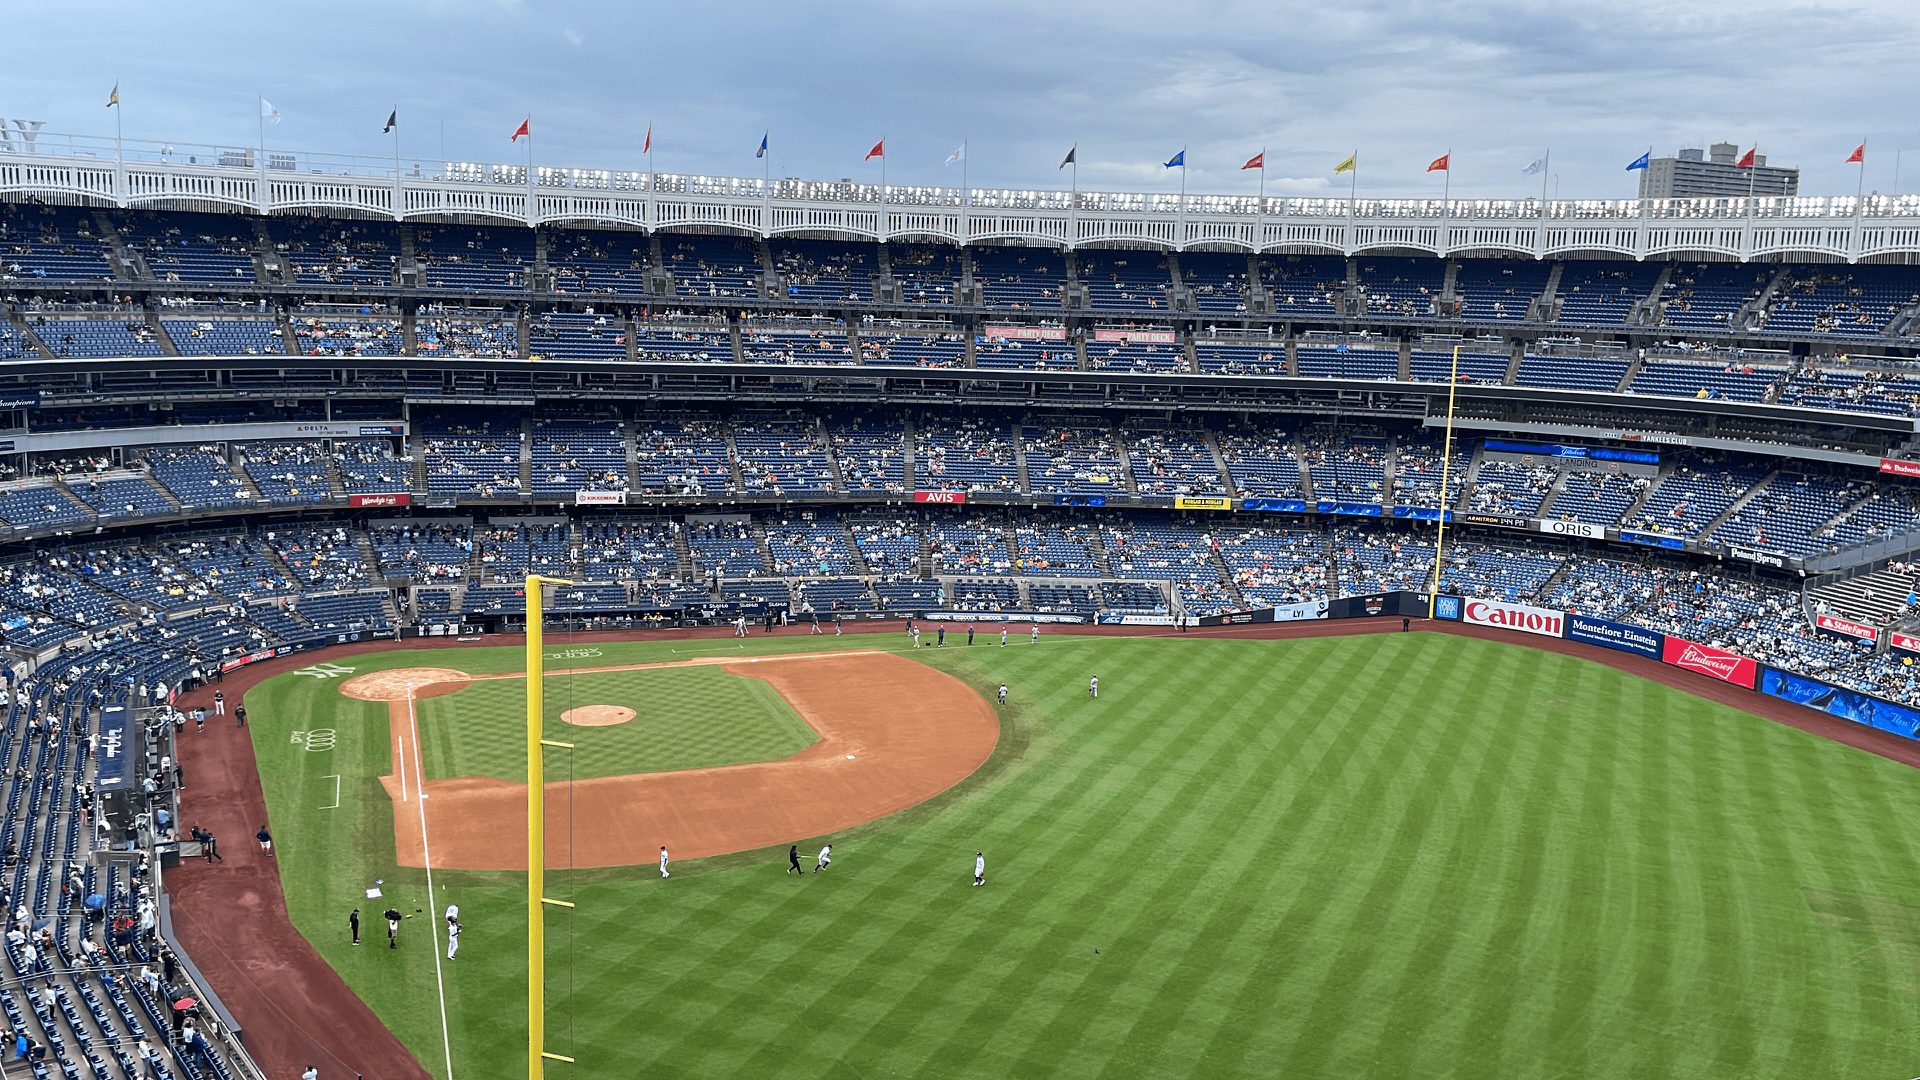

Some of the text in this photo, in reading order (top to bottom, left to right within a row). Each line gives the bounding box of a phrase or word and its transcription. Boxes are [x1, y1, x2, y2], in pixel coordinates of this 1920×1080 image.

[1018, 329, 1040, 338] PARTY
[1042, 330, 1062, 338] DECK
[1127, 333, 1150, 341] PARTY
[1152, 333, 1171, 342] DECK
[0, 399, 35, 408] hampions
[1643, 435, 1670, 443] YANKEES
[1671, 437, 1687, 445] CLUB
[1560, 458, 1598, 468] LANDING
[361, 496, 386, 506] Wendy's
[926, 492, 954, 502] AVIS
[1467, 515, 1499, 523] ARMITRON
[1553, 522, 1592, 536] ORIS
[1731, 548, 1783, 567] Poland Spring
[1466, 602, 1561, 634] Canon
[1572, 619, 1657, 647] Montefiore Einstein
[1833, 620, 1872, 637] State Farm
[1683, 649, 1733, 671] Budweiser
